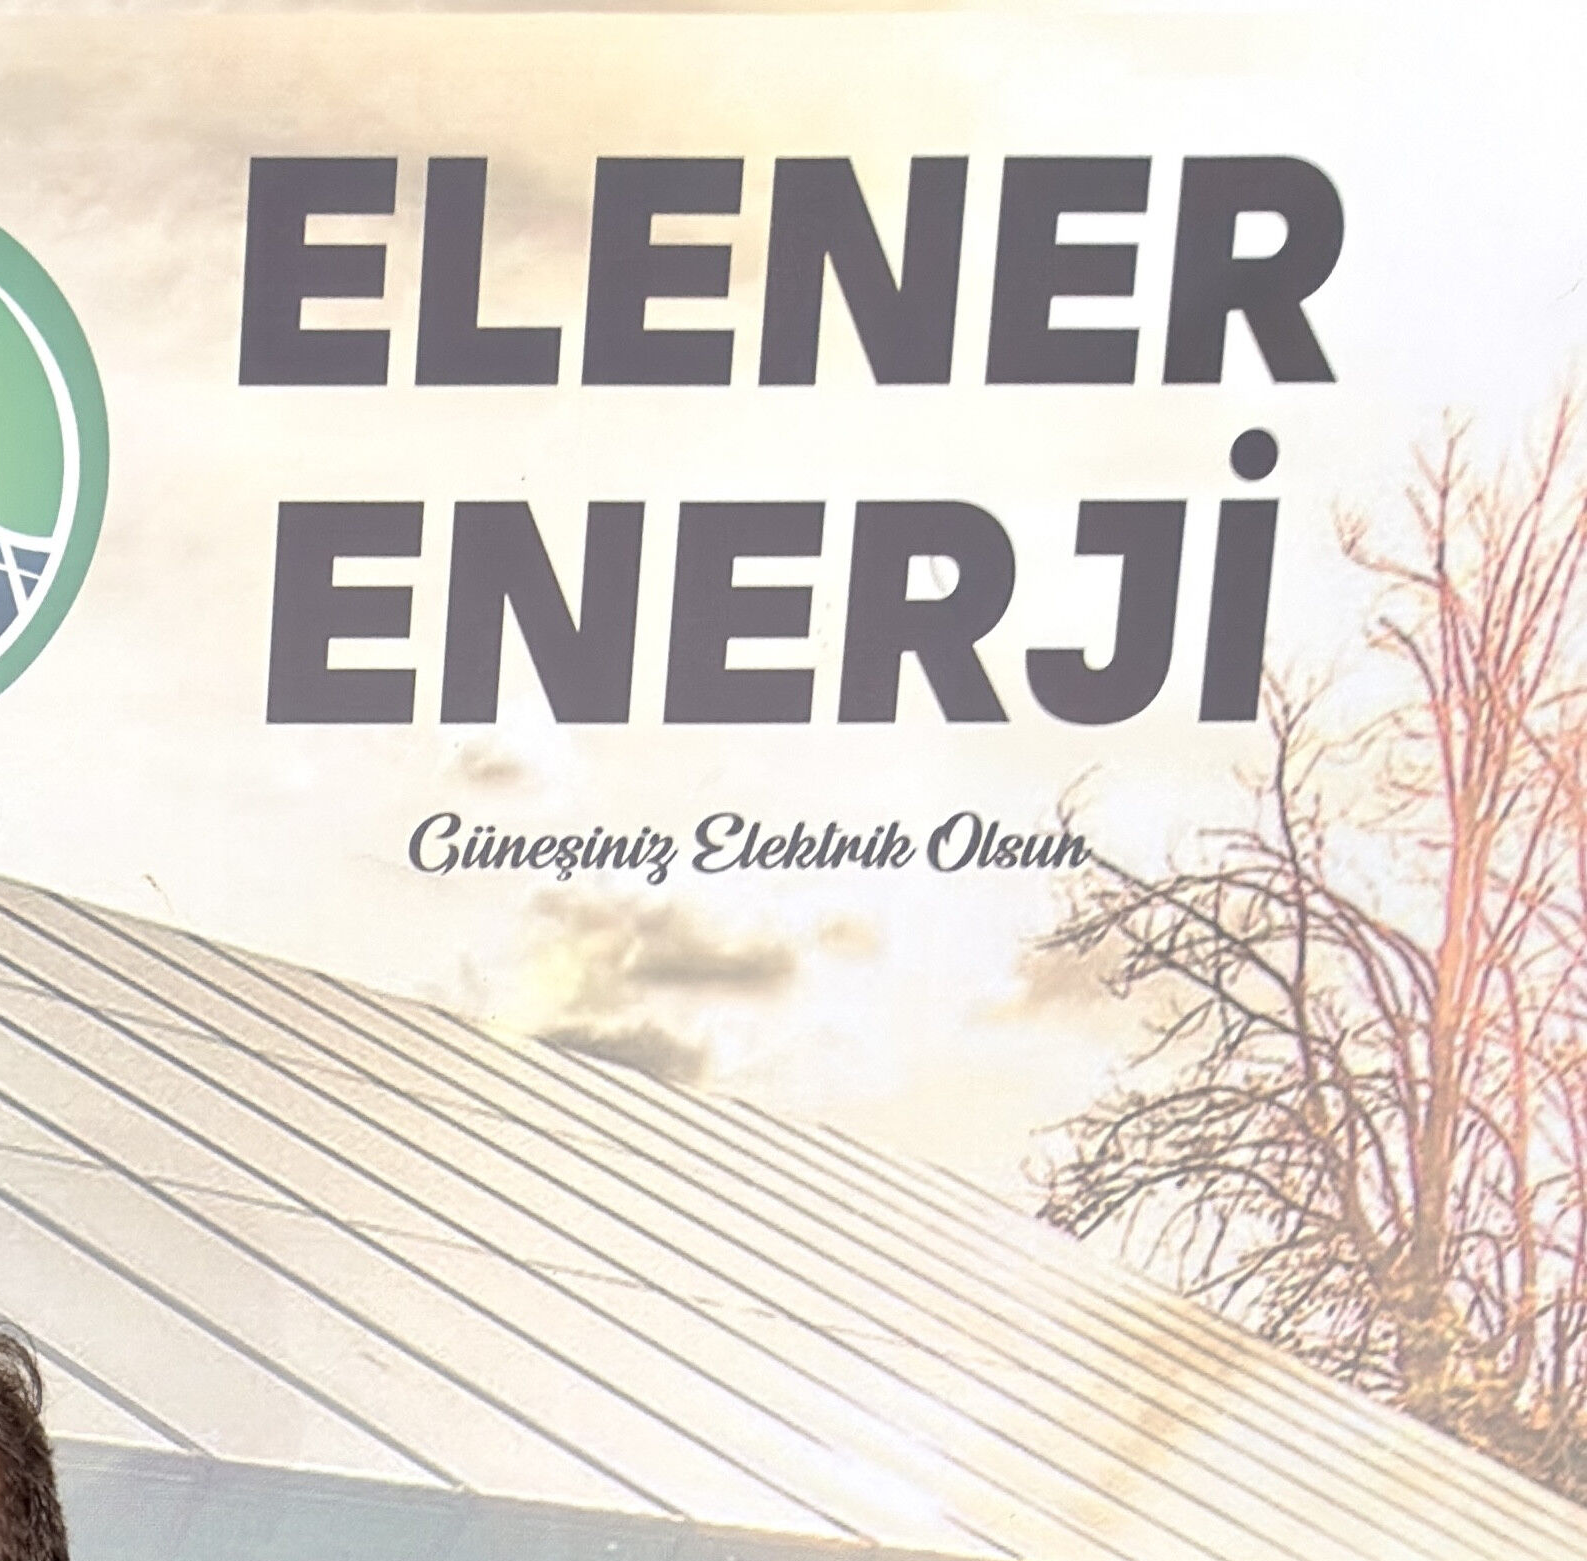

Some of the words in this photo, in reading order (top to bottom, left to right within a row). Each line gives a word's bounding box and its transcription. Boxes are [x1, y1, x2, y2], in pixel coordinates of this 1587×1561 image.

[238, 156, 1345, 386] ELENER
[266, 429, 1279, 725] ENERJİ
[409, 812, 678, 885] Güneşiniz
[691, 812, 917, 873] Elektrik
[926, 811, 1093, 871] Olsun
